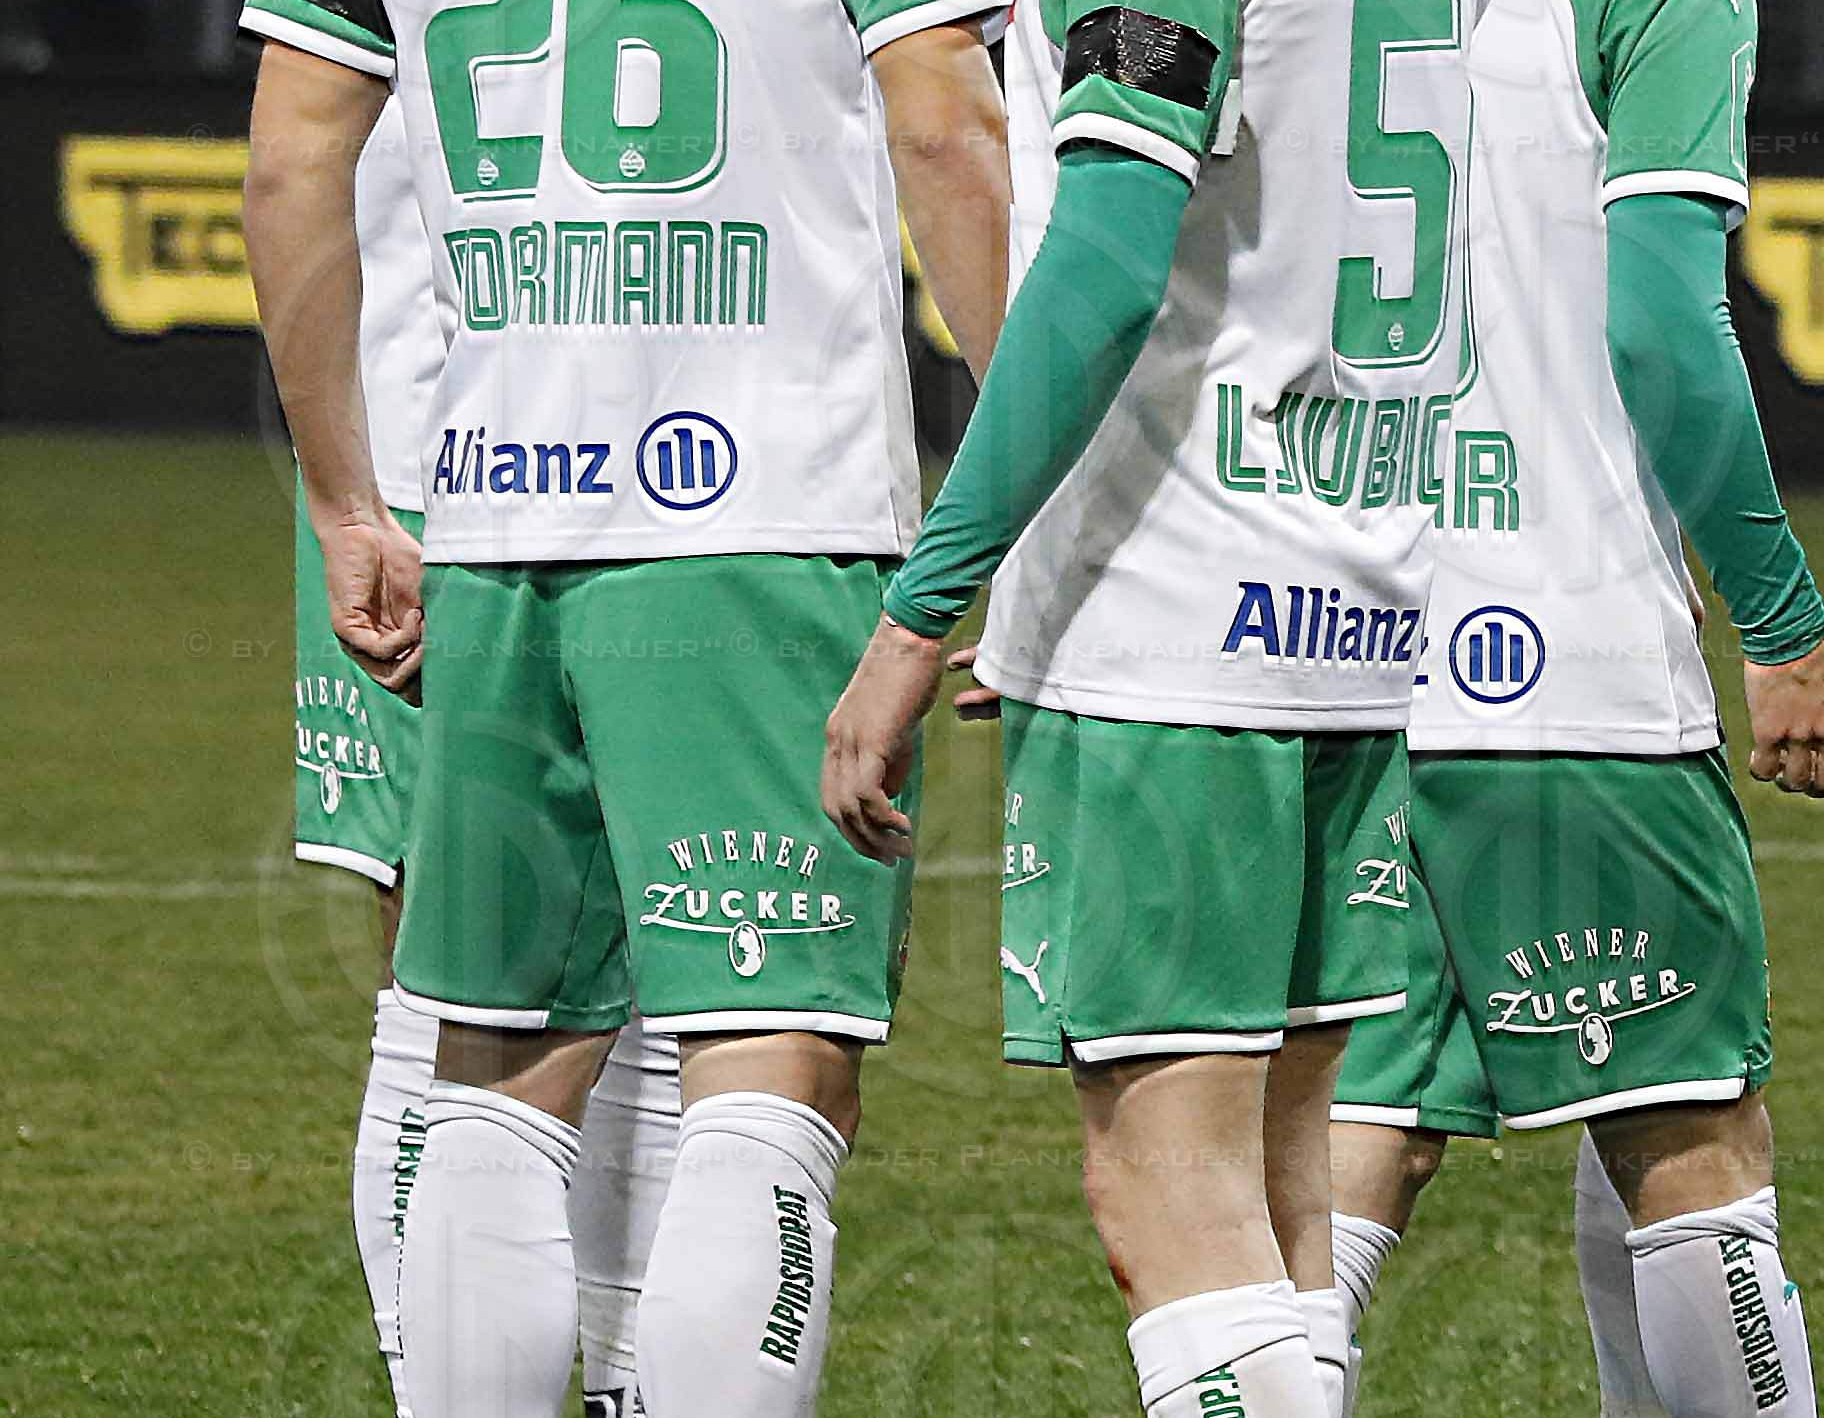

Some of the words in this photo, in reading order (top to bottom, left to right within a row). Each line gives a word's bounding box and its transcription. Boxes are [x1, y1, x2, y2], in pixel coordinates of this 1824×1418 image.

[1221, 581, 1421, 663] Allianz
[296, 720, 384, 779] UCKER
[668, 830, 820, 877] WIENER
[640, 883, 856, 934] ZUCKER
[1505, 927, 1650, 979] WIENER
[1486, 969, 1697, 1033] ZUCKER
